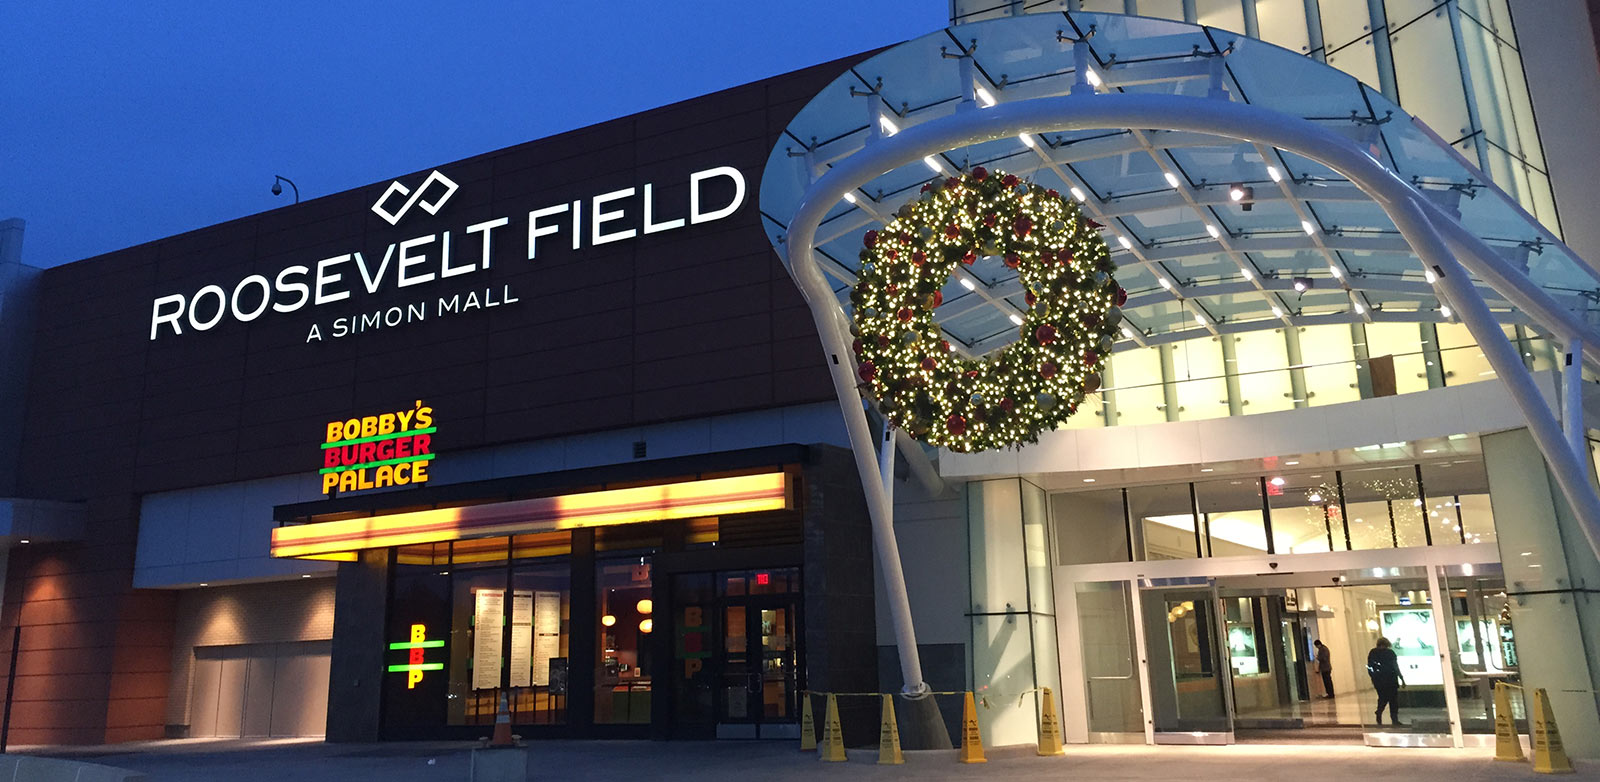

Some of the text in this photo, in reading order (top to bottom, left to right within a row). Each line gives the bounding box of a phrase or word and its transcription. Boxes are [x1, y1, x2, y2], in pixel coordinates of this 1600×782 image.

[150, 166, 746, 341] ROOSEVELT FIELD
[306, 284, 519, 344] A SIMON MALL
[326, 400, 434, 444] BOBBY'S
[324, 433, 432, 468] BURGER
[322, 459, 429, 495] PALACE
